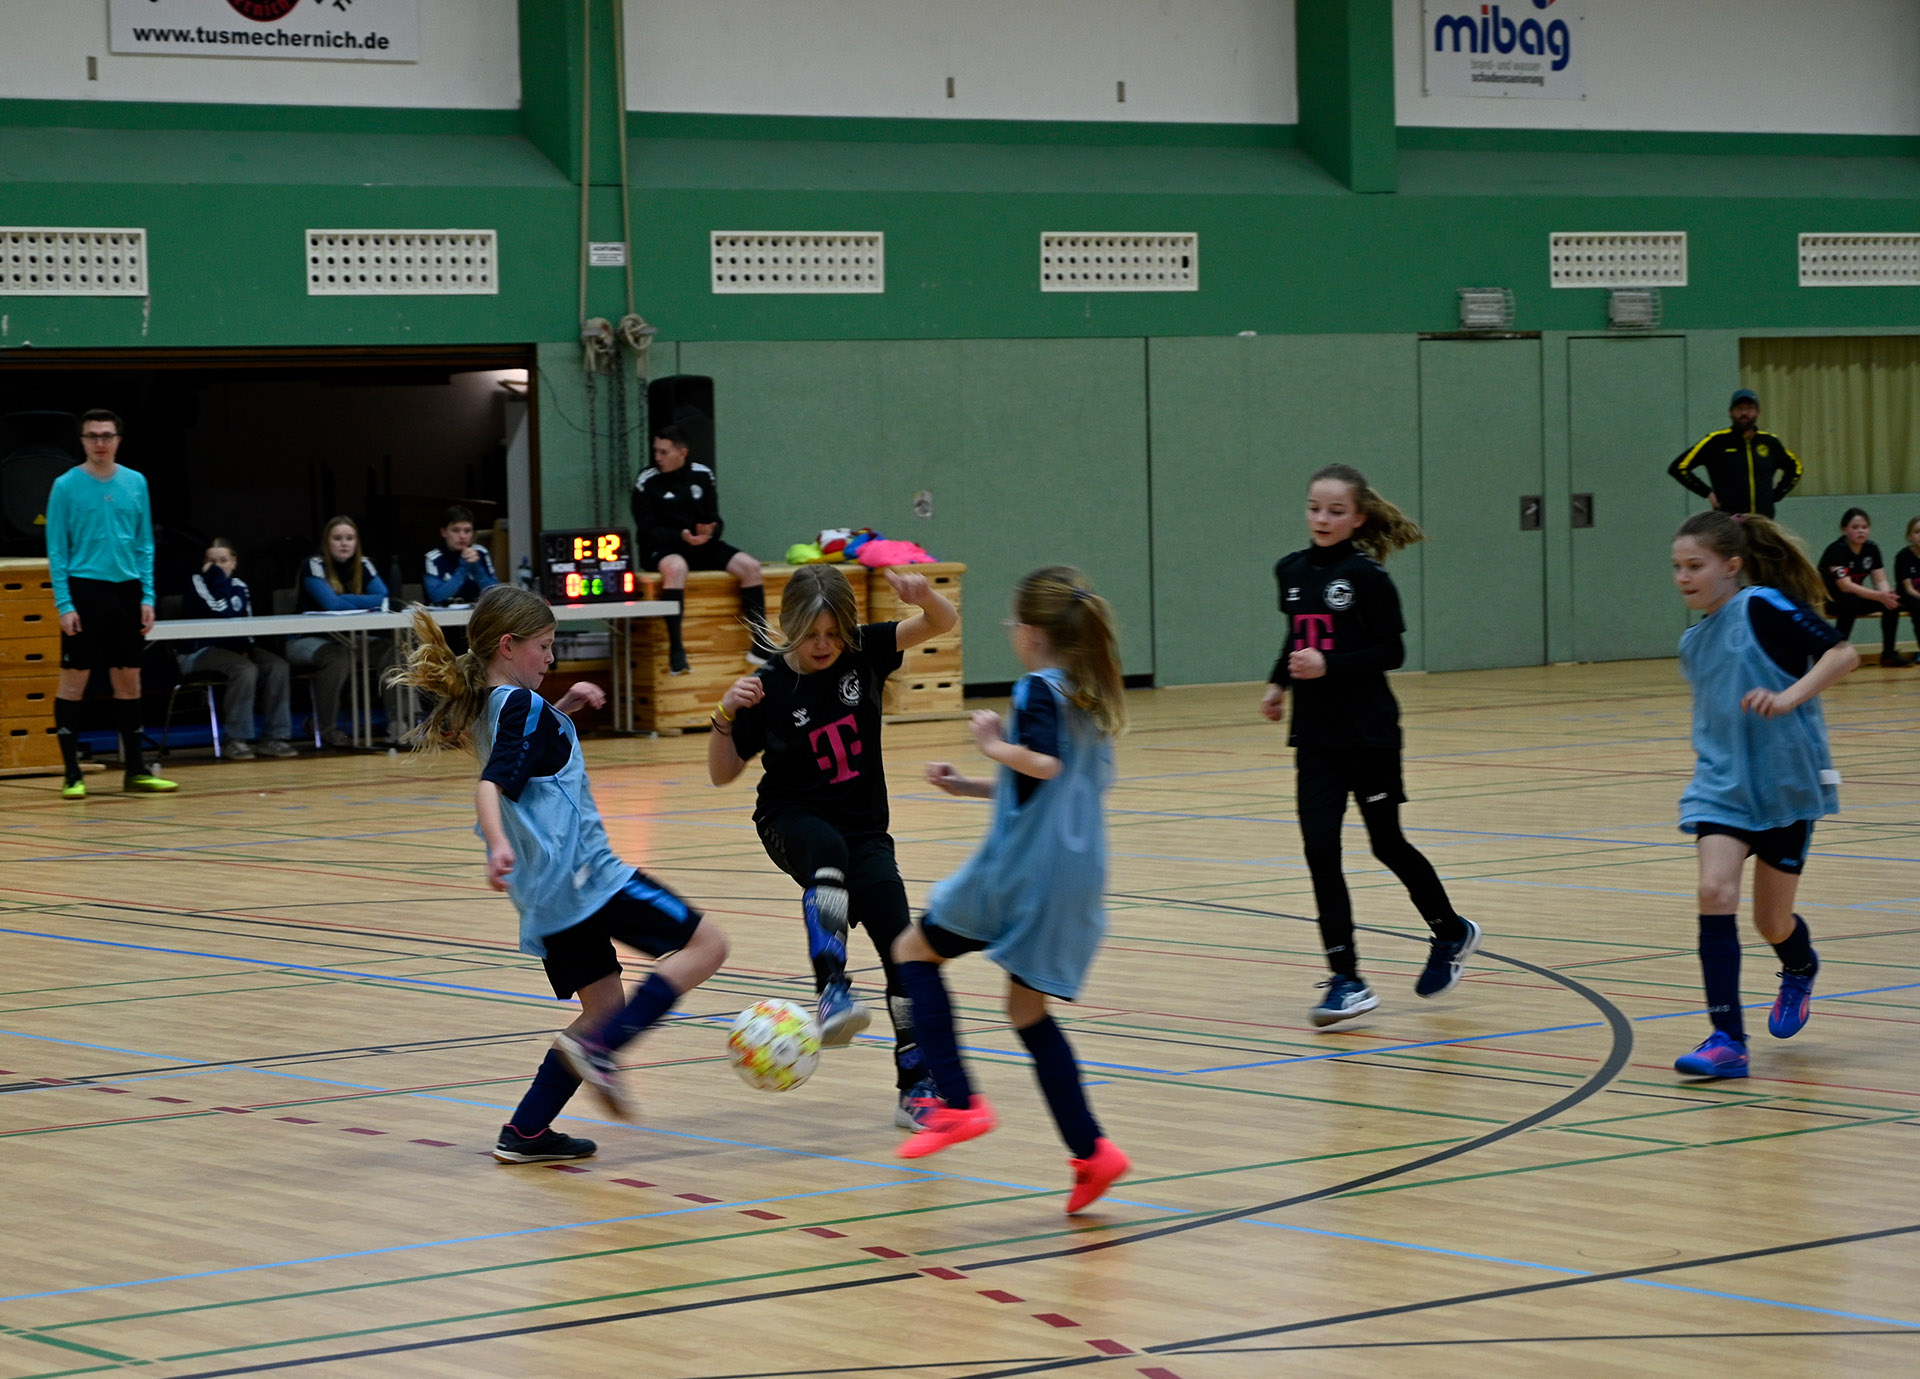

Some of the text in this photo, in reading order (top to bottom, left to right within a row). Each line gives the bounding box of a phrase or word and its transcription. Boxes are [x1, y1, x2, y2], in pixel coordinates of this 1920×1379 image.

[133, 27, 390, 50] www.tusmechernich.de
[1434, 5, 1570, 71] mibag
[1293, 614, 1334, 650] T
[808, 713, 862, 784] T
